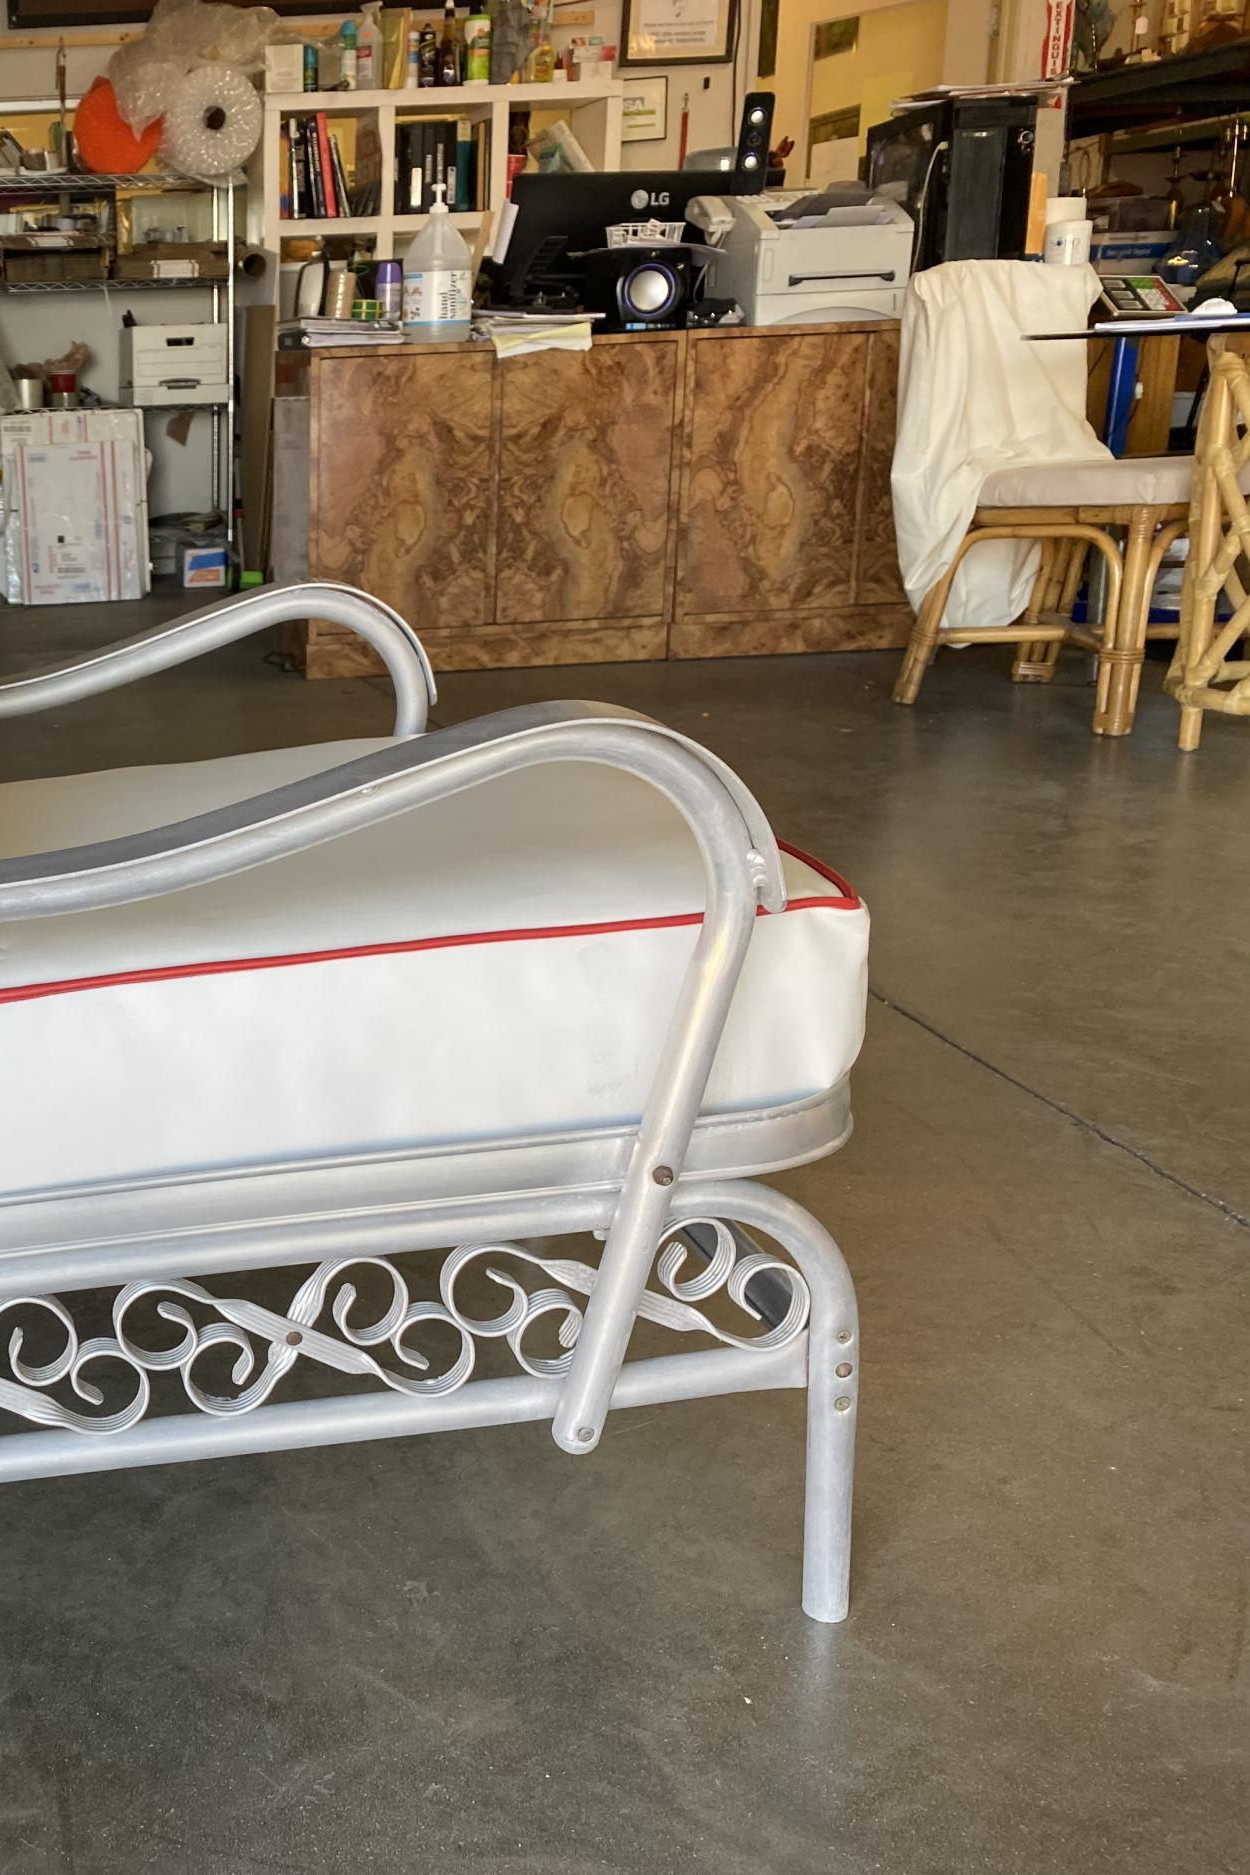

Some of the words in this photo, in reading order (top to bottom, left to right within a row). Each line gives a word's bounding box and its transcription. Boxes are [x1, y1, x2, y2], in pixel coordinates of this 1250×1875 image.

[651, 192, 670, 206] LG
[438, 292, 448, 319] hand
[448, 271, 458, 319] sanitizer
